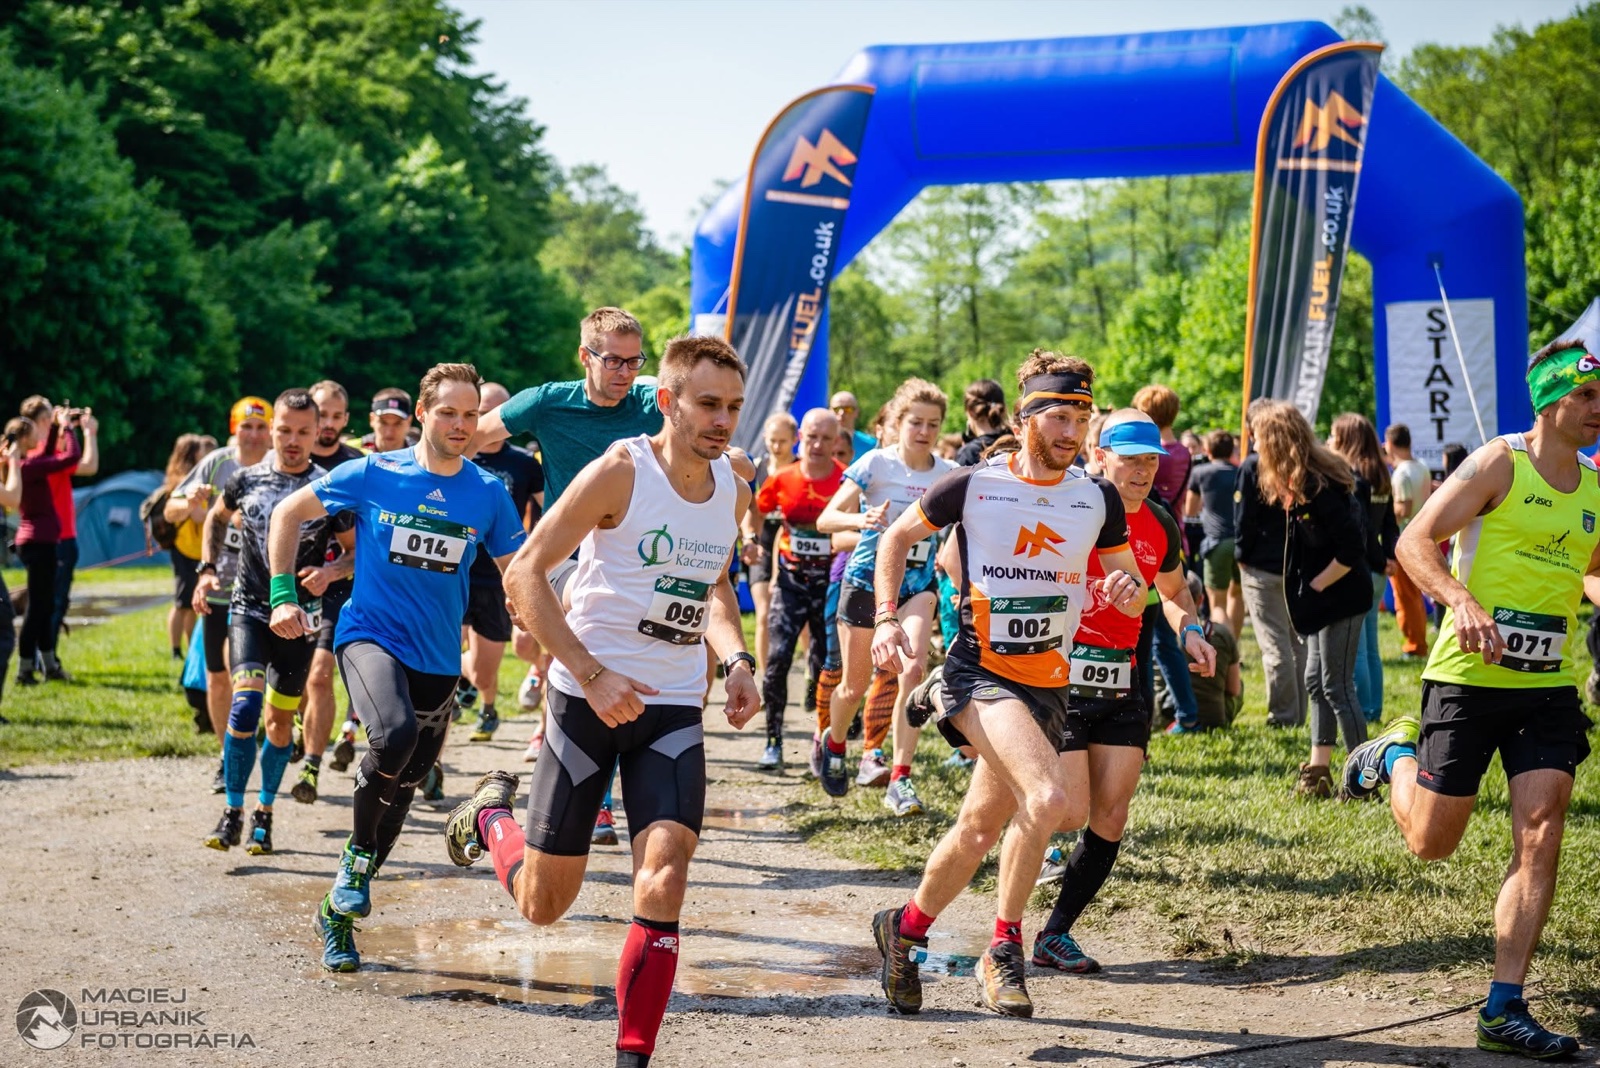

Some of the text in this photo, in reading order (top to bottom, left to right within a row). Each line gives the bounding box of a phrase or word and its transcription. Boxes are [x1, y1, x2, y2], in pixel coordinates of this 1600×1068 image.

[1295, 184, 1344, 418] UNTAINFUEL.co.uk
[1424, 307, 1454, 442] START
[985, 495, 1019, 503] LEDLENSER
[1535, 496, 1553, 508] asics
[407, 533, 449, 558] 014
[678, 537, 730, 559] Fizjoterapi
[796, 540, 821, 552] 094
[982, 565, 1081, 585] MOUNTAINFUEL
[664, 602, 705, 628] 099
[1008, 617, 1051, 638] 002
[1507, 632, 1552, 656] 071
[1082, 665, 1120, 684] 091
